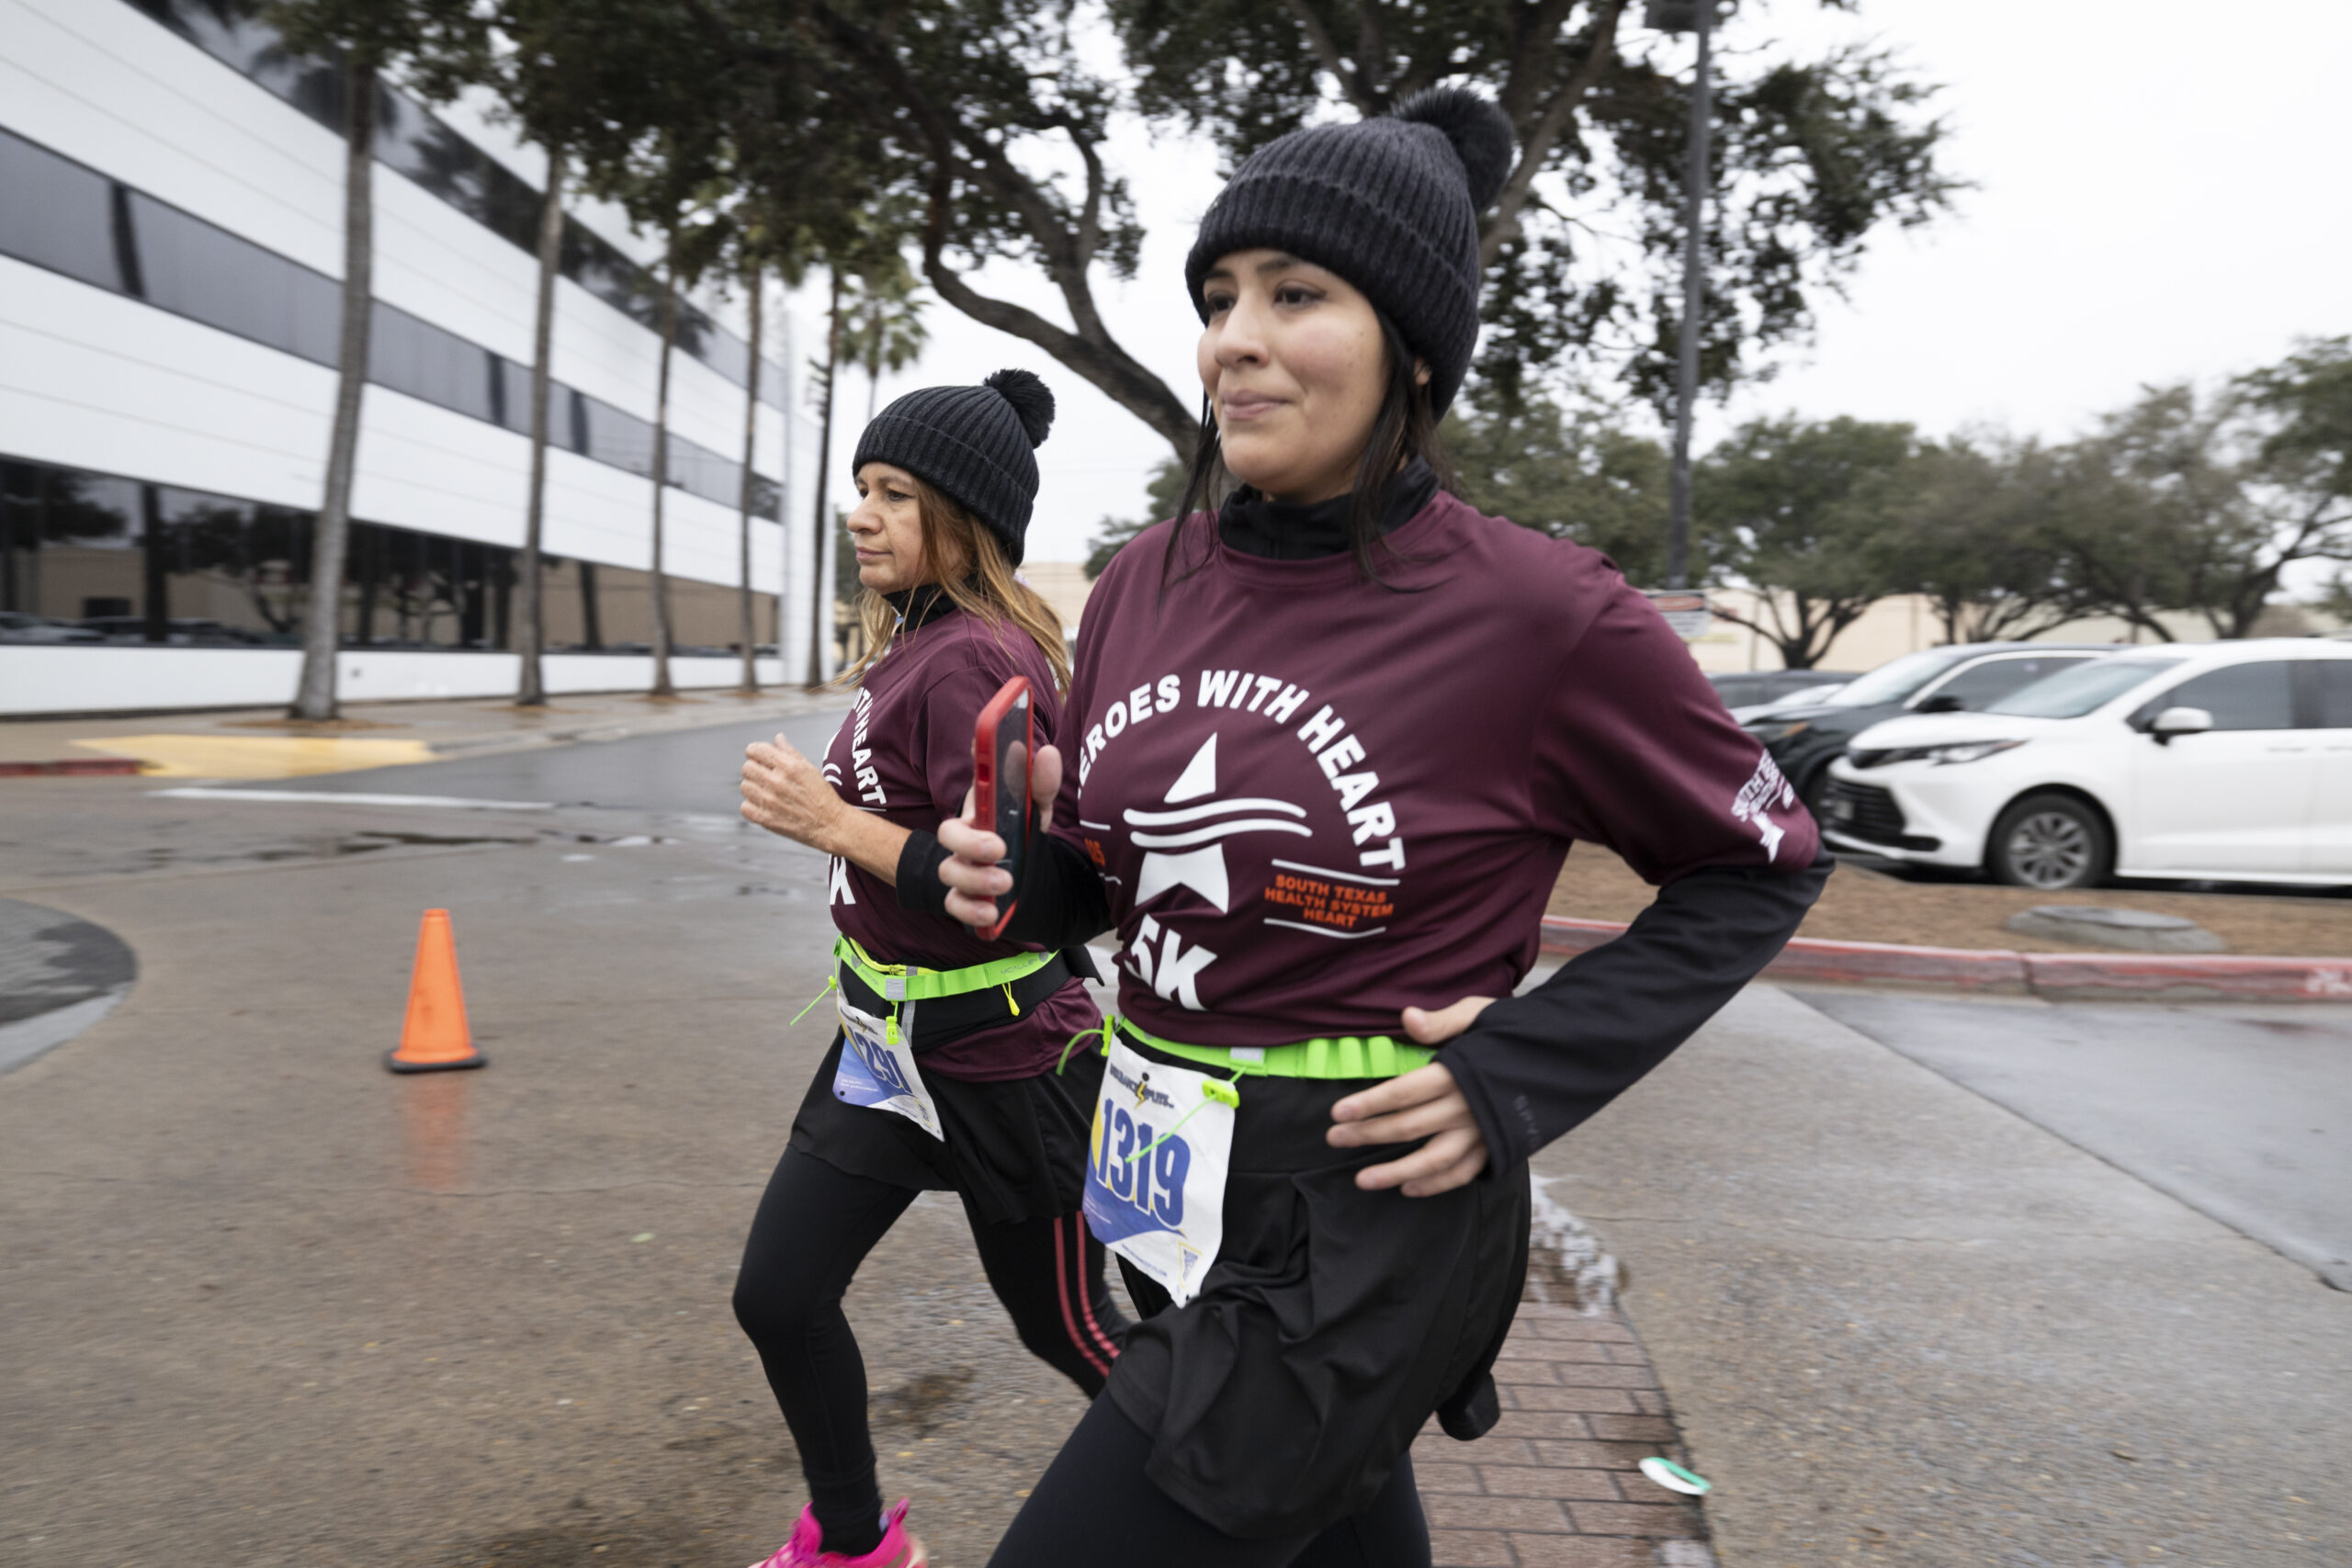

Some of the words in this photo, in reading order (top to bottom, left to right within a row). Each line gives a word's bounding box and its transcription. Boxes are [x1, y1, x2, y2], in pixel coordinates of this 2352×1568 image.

[852, 711, 888, 806] HEART
[1078, 673, 1181, 800] EROES
[1197, 670, 1310, 725] WITH
[1296, 704, 1406, 871] HEART
[1264, 886, 1326, 908] HEALTH
[1329, 899, 1395, 918] SYSTEM
[1275, 874, 1330, 897] SOUTH
[1334, 886, 1387, 904] TEXAS
[1303, 908, 1358, 929] HEART
[1124, 913, 1218, 1010] 5K
[1098, 1098, 1192, 1229] 1319
